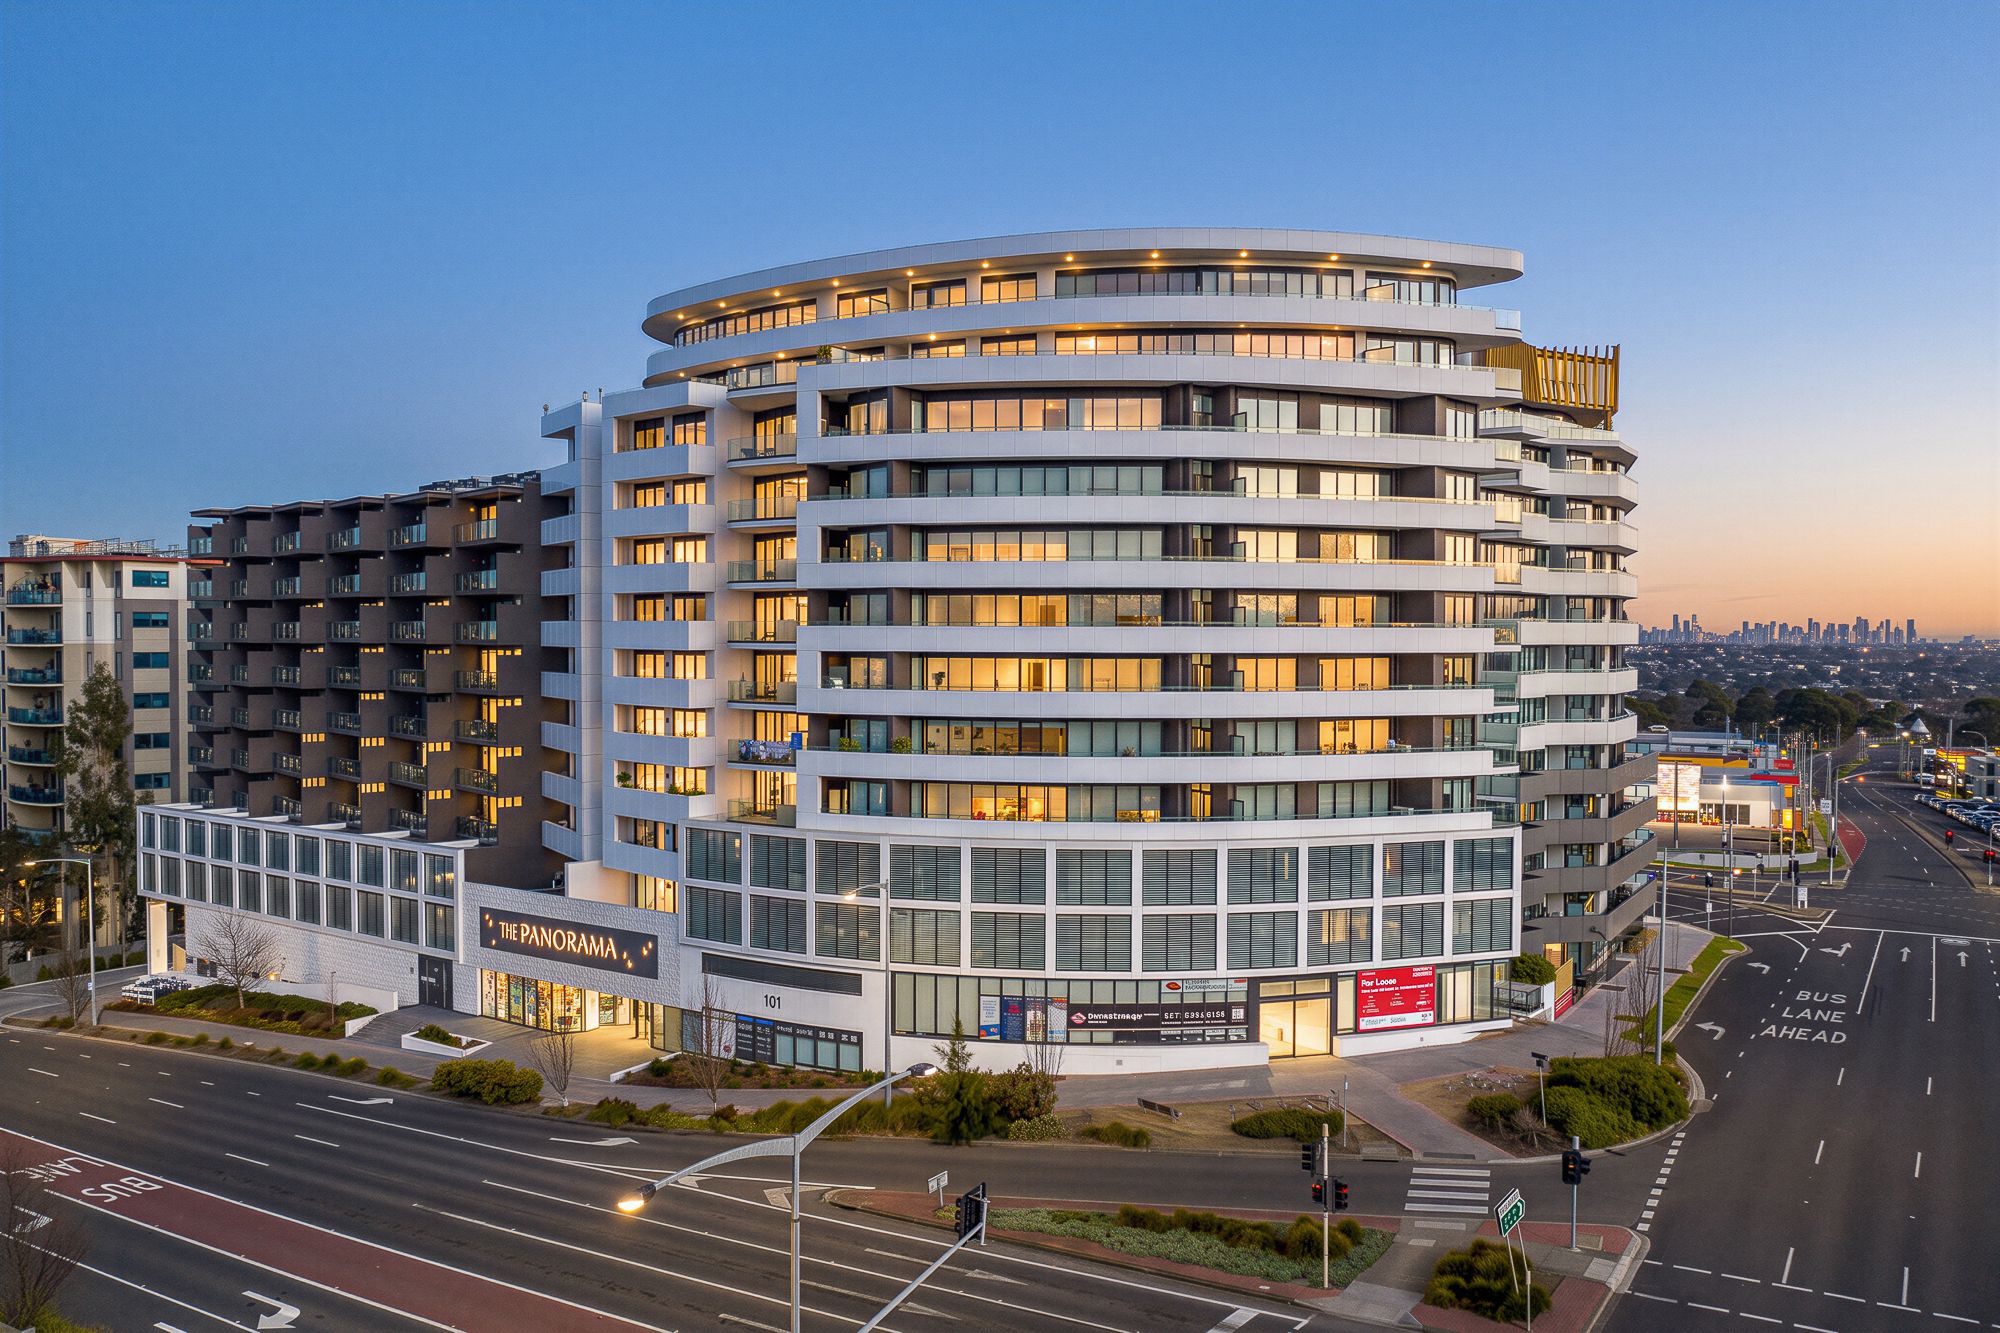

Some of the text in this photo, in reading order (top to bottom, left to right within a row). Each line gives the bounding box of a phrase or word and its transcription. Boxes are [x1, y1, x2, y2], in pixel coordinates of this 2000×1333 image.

[498, 921, 617, 960] THE PANORAMA
[763, 994, 781, 1010] 101
[1795, 990, 1847, 1004] BUS
[1781, 1006, 1846, 1023] LANE
[1760, 1024, 1847, 1044] AHEAD
[81, 1176, 164, 1203] BUS
